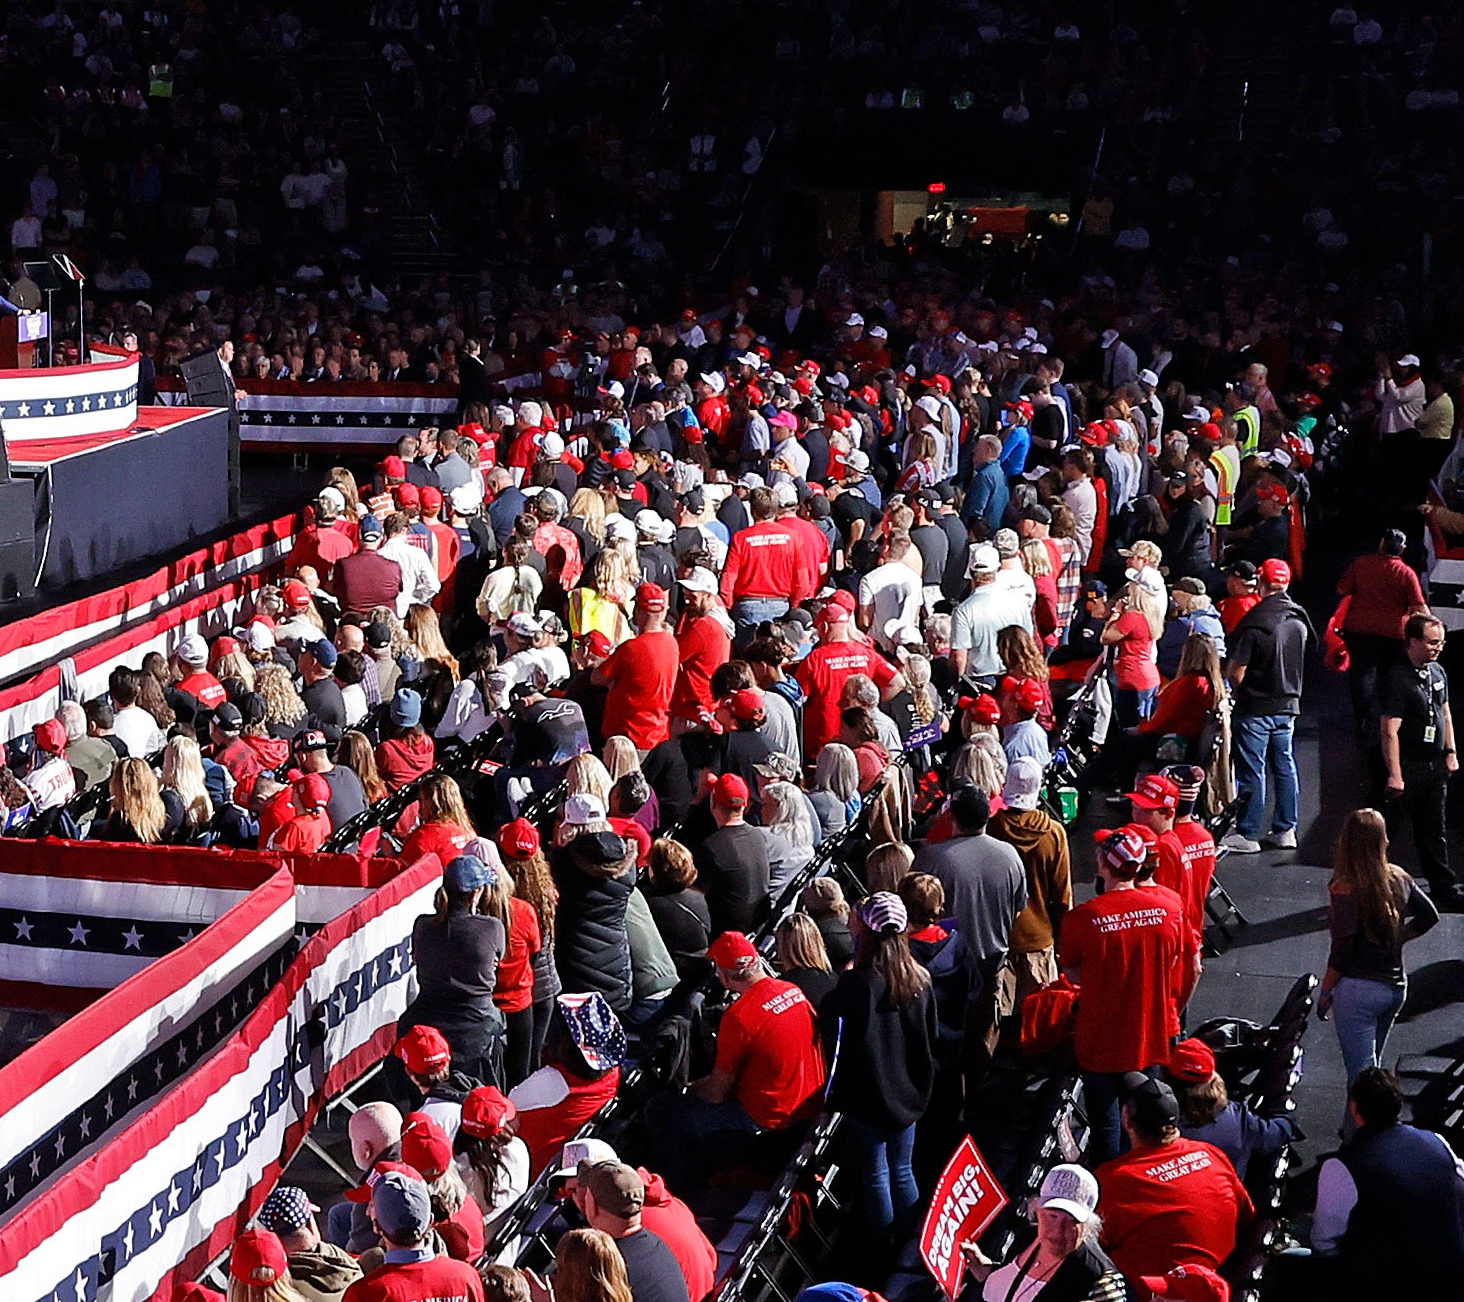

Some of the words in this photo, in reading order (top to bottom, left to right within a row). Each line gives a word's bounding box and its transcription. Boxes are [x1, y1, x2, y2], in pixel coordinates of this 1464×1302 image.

[1092, 915, 1121, 927] MAKE
[1122, 908, 1168, 922] AMERICA
[1101, 922, 1132, 934] GREAT
[1133, 916, 1163, 928] AGAIN
[762, 997, 780, 1013] MAKE
[1145, 1161, 1175, 1178] MAKE
[1175, 1151, 1210, 1168] AMERICA
[1158, 1166, 1188, 1182] GREAT
[1189, 1159, 1212, 1174] AGAIN
[929, 1197, 954, 1267] DREAM
[950, 1163, 981, 1201] BIG,
[939, 1178, 985, 1281] AGAIN!
